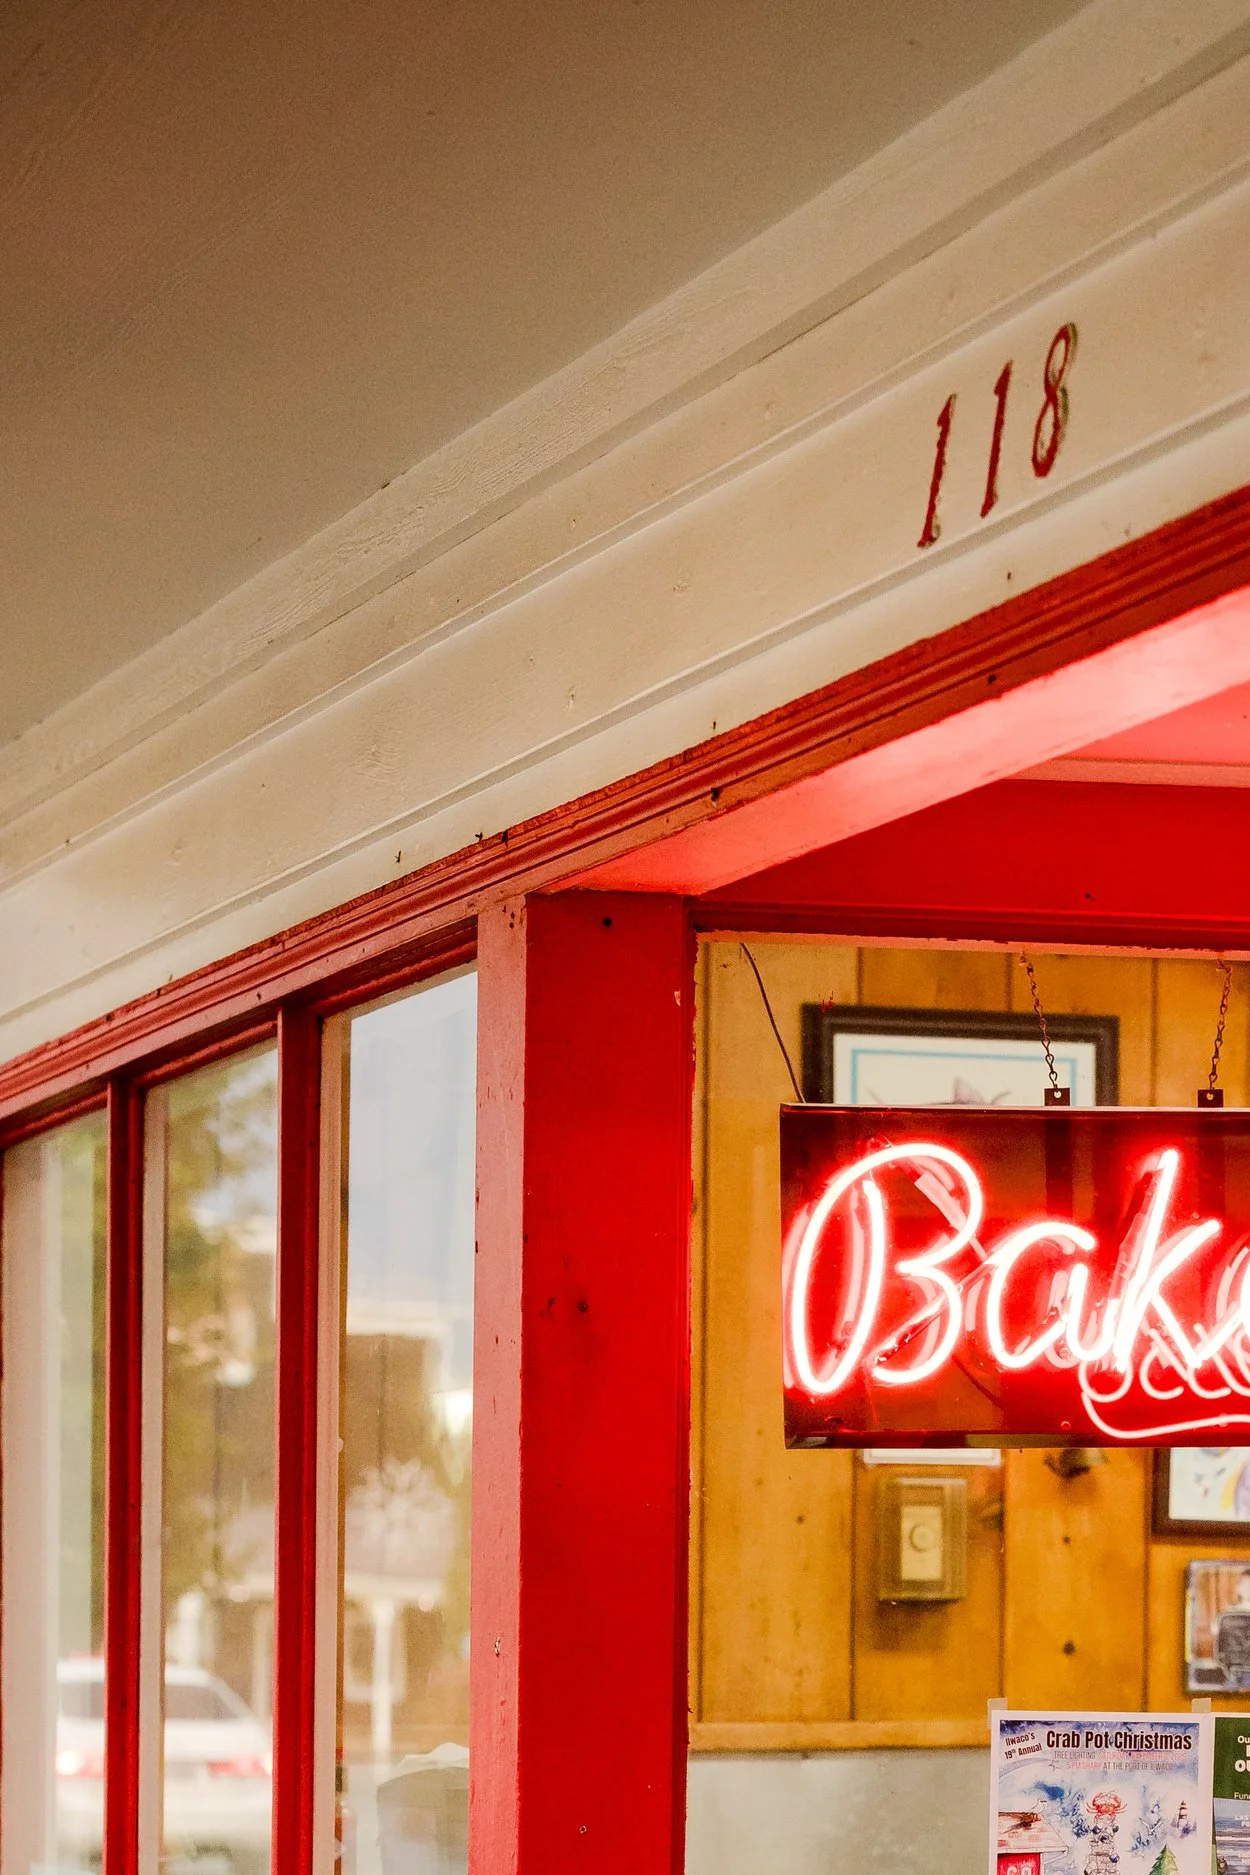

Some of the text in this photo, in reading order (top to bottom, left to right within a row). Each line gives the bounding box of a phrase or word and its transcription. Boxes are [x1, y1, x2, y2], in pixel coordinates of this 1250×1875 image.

[916, 321, 1079, 549] 118
[1005, 1732, 1036, 1746] Ilwaco's
[1046, 1731, 1192, 1750] Crab Pot Christmas
[1018, 1743, 1042, 1756] Annual
[1054, 1751, 1068, 1759] TREE
[1069, 1751, 1095, 1759] LIGHTING
[1103, 1762, 1110, 1770] AT
[1112, 1762, 1123, 1770] THE
